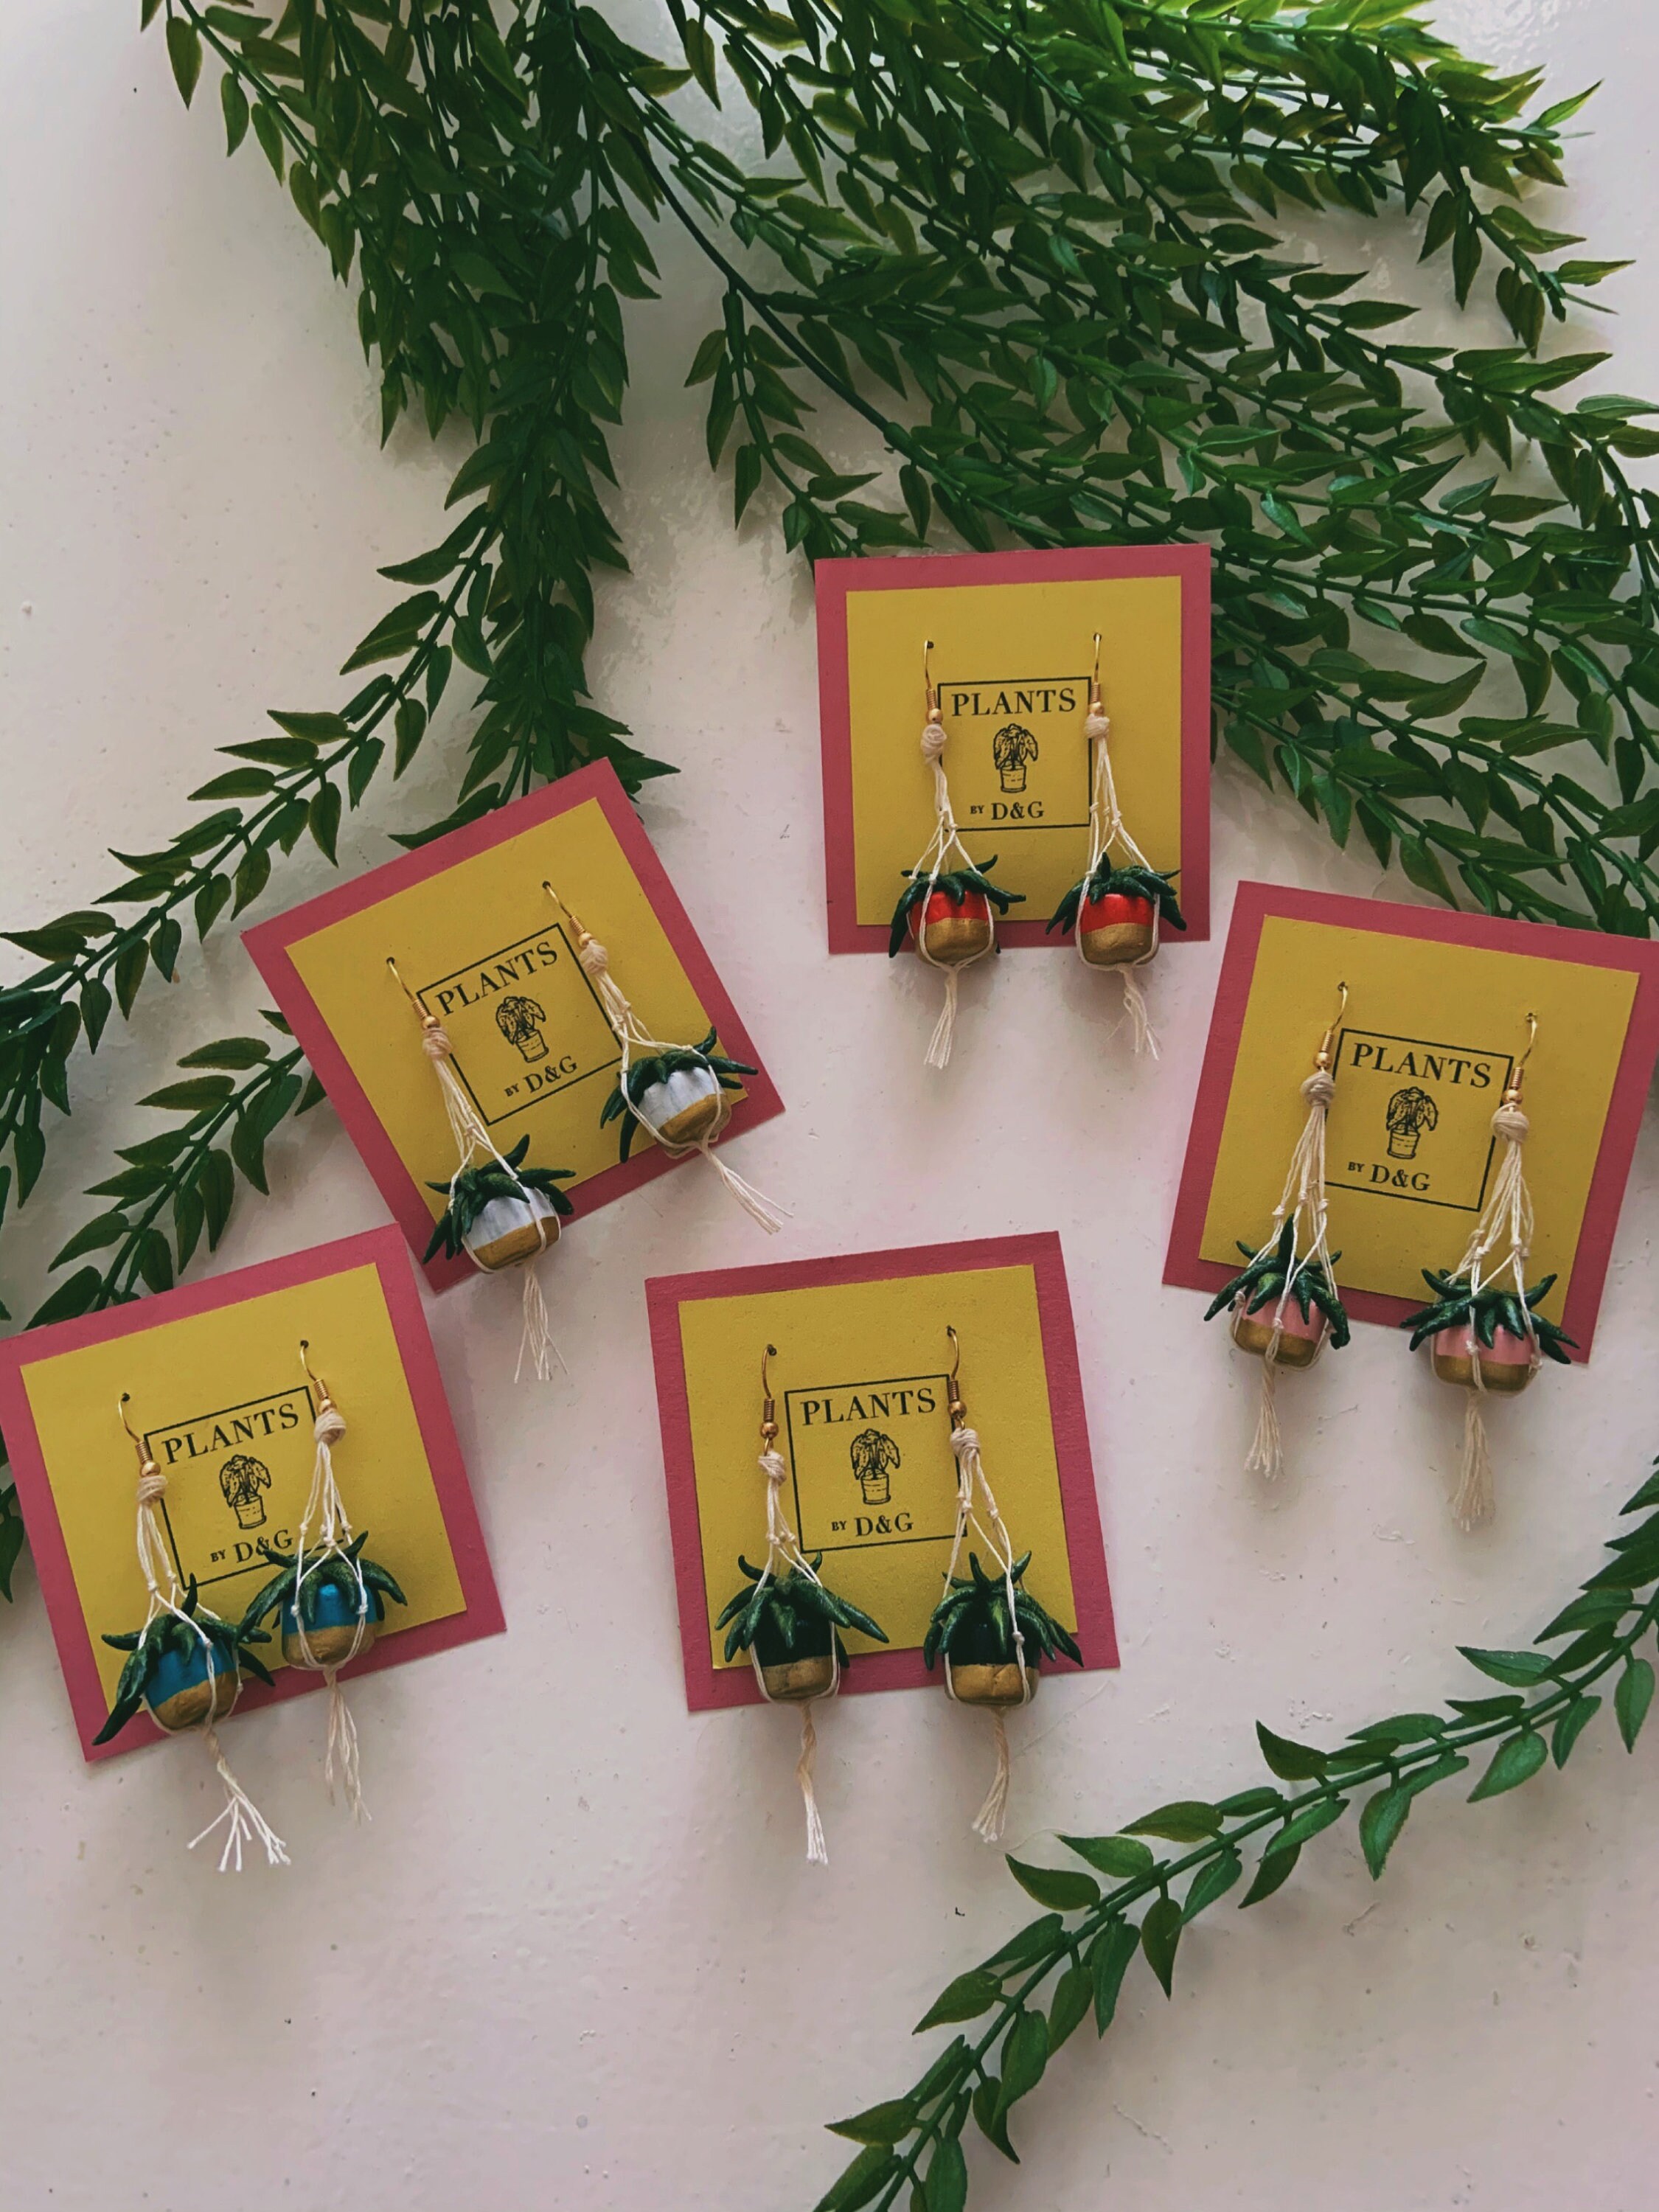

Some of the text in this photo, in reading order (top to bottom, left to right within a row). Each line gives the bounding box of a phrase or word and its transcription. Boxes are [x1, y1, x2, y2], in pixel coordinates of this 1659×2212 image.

[951, 688, 1076, 717] PLANTS
[970, 801, 1044, 820] BY D&G
[434, 942, 557, 1016] PLANTS
[504, 1055, 577, 1097] BY D&G
[1350, 1043, 1491, 1088] PLANTS
[1347, 1161, 1430, 1191] BY D&G
[800, 1388, 936, 1426] PLANTS
[161, 1403, 299, 1465] PLANTS
[831, 1512, 914, 1537] BY D&G
[209, 1528, 293, 1564] BY D&G
